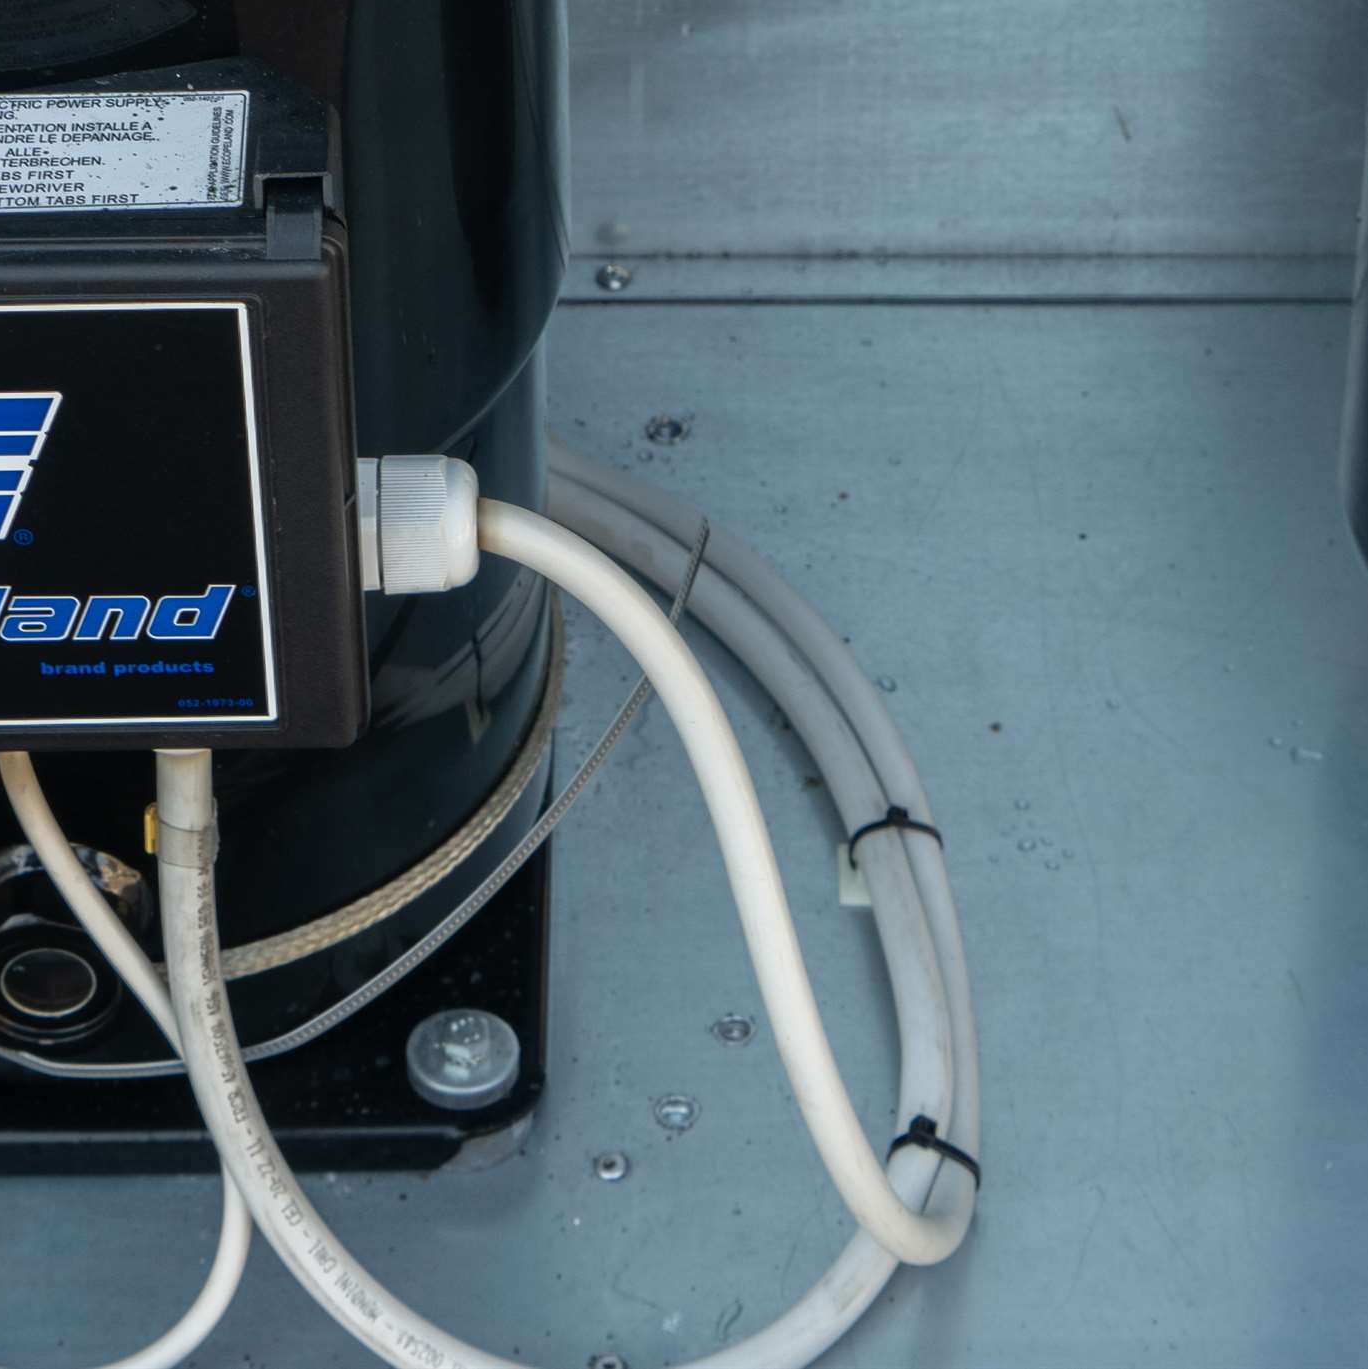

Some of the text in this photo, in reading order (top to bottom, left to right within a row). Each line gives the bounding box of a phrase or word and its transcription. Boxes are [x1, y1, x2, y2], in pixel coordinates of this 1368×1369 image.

[46, 98, 101, 109] POWER
[71, 121, 138, 132] INSTALLE
[142, 121, 152, 131] A
[211, 106, 222, 144] GUIDELINES
[39, 133, 58, 144] LE
[28, 170, 74, 180] FIRST
[47, 195, 86, 206] TABS
[92, 194, 139, 205] FIRST
[40, 659, 215, 677] brand products
